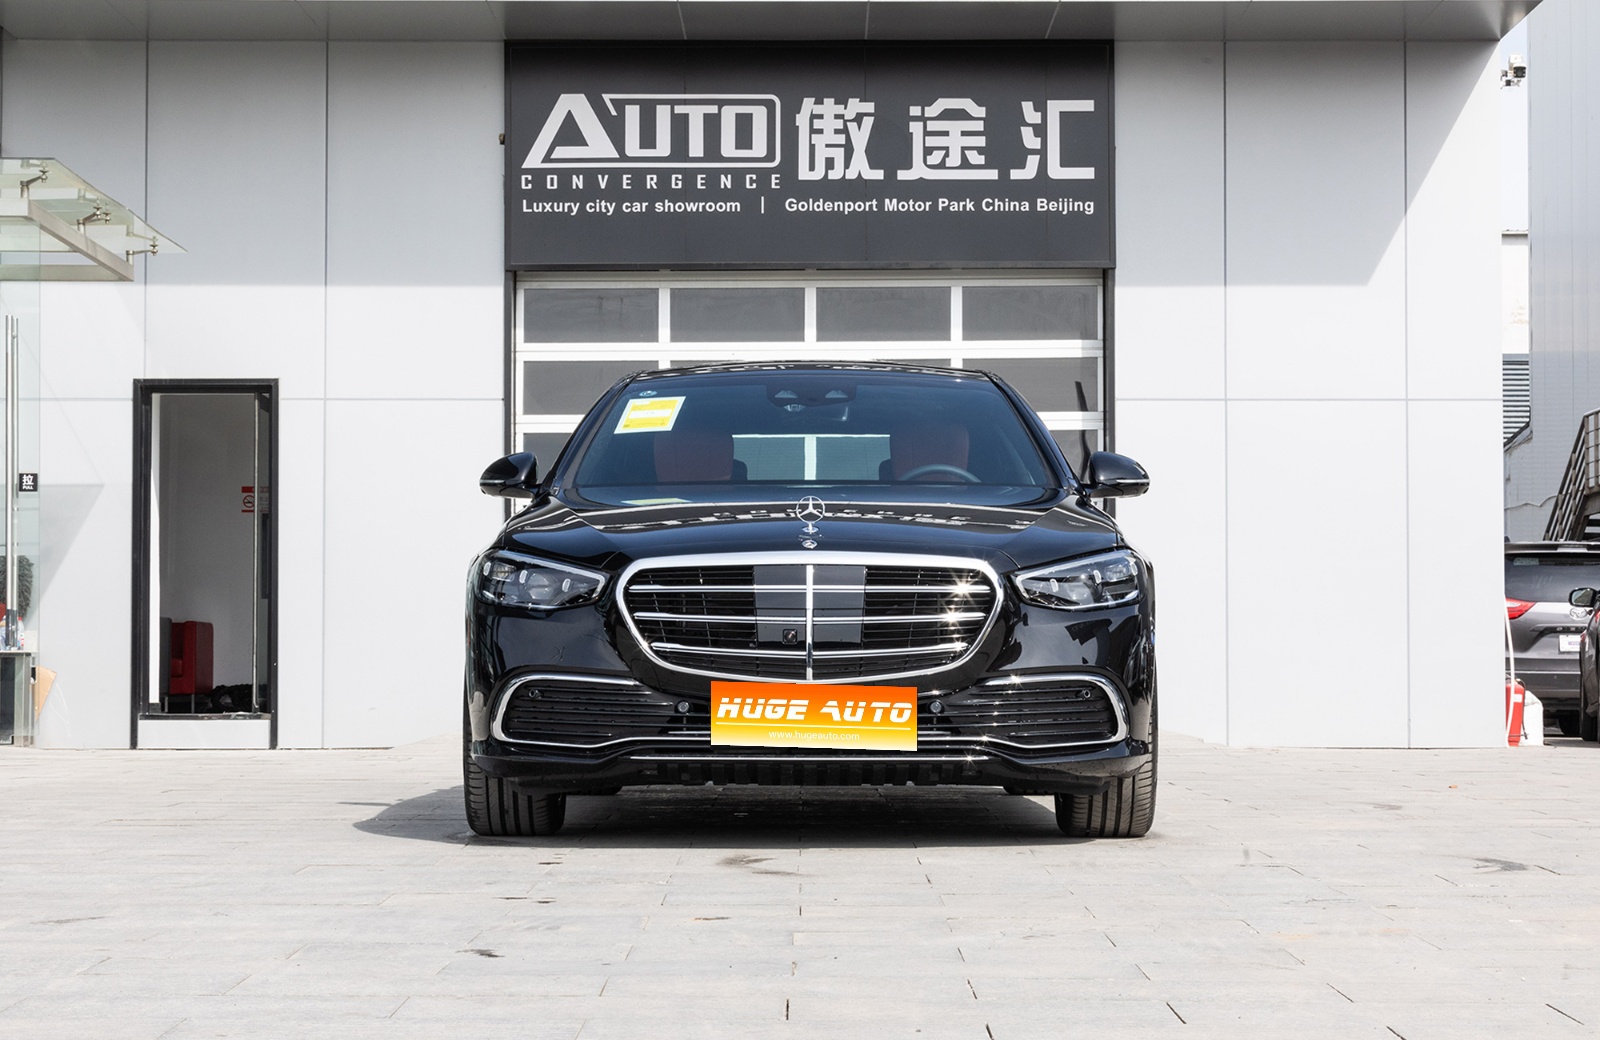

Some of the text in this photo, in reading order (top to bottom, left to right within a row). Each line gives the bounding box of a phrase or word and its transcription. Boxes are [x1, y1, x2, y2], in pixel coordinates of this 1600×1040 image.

[521, 93, 781, 169] AUTO
[796, 97, 1096, 181] 傲途汇
[521, 174, 780, 189] CONVERGENCE
[522, 198, 741, 216] Luxury city car showroom
[785, 197, 1095, 215] Goldenport Motor Park China Beijing
[22, 474, 34, 485] 拉
